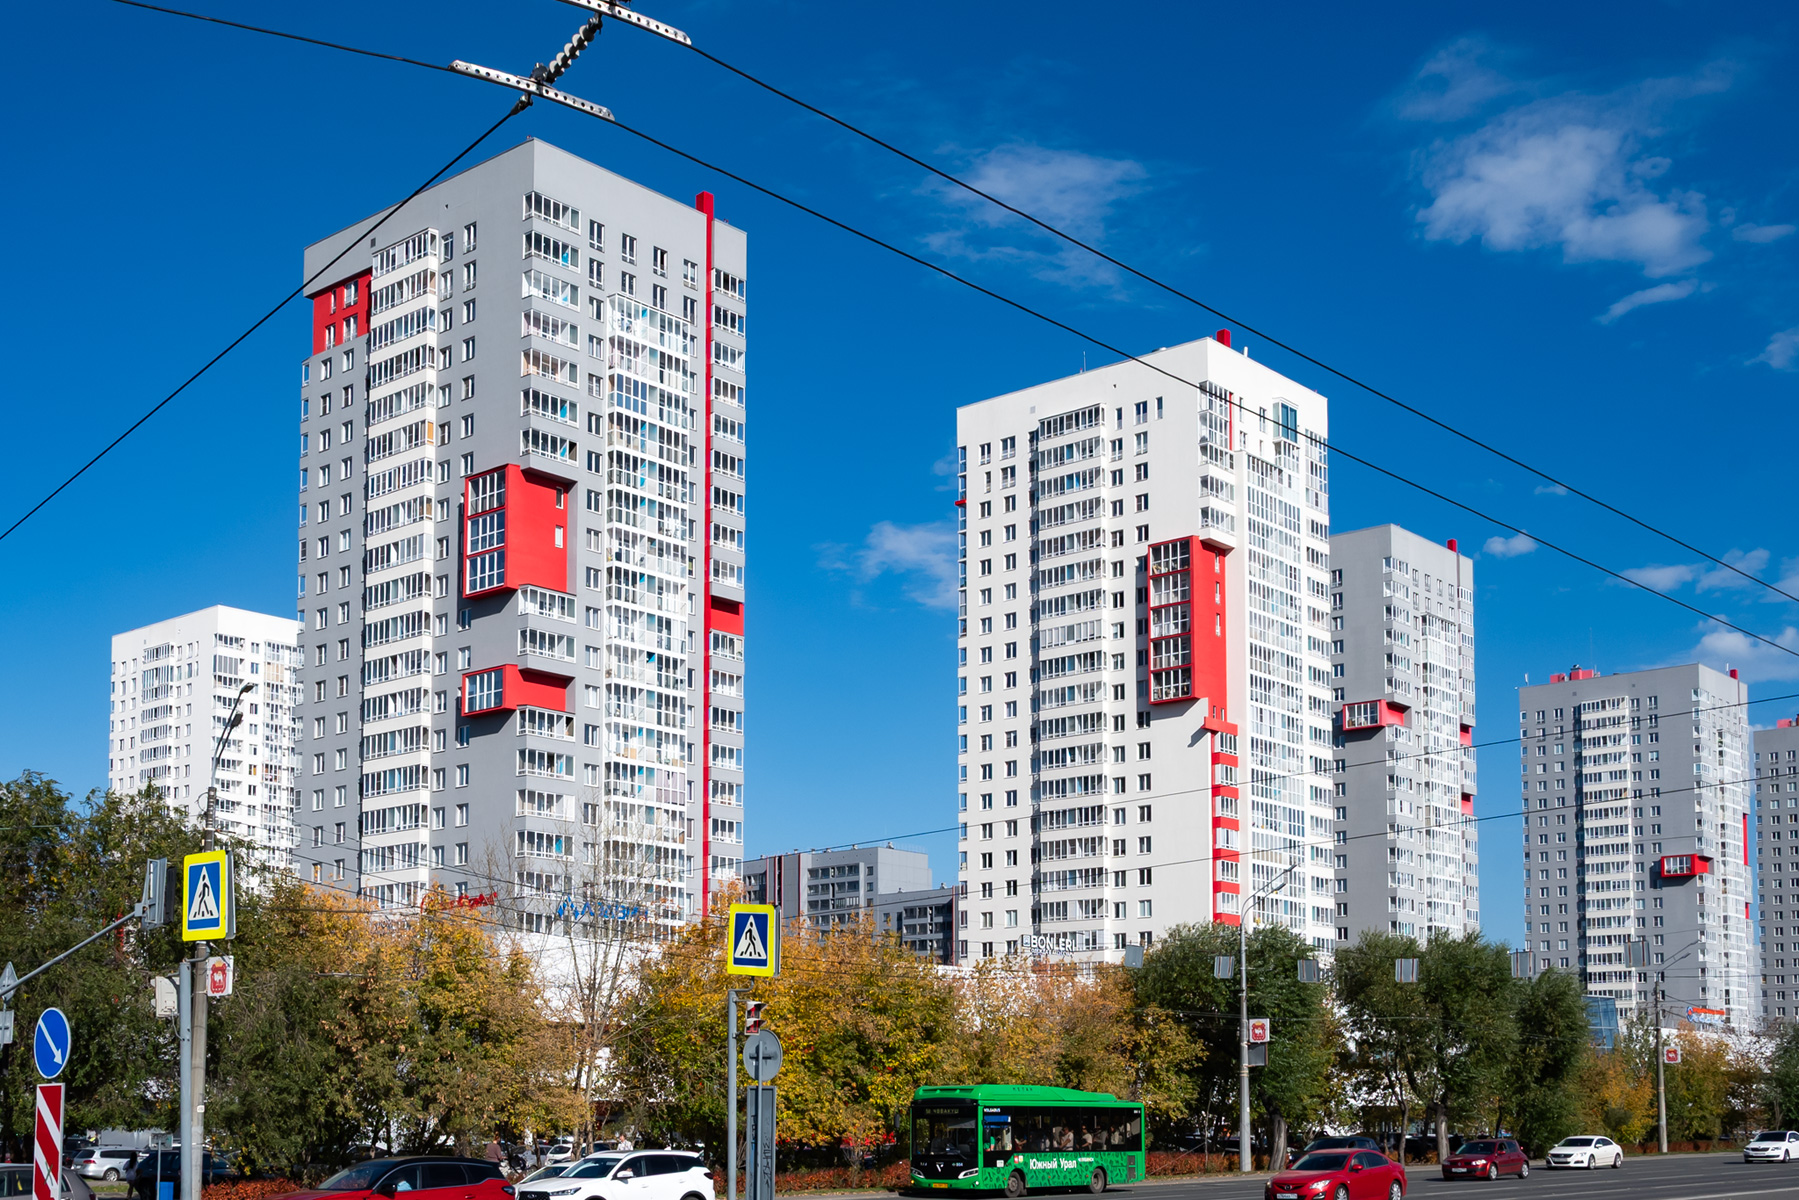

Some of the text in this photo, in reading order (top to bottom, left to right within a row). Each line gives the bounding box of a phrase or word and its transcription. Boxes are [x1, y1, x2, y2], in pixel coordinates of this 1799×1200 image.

[1031, 936, 1075, 952] BONLERI
[1029, 1157, 1077, 1171] Южный Урал
